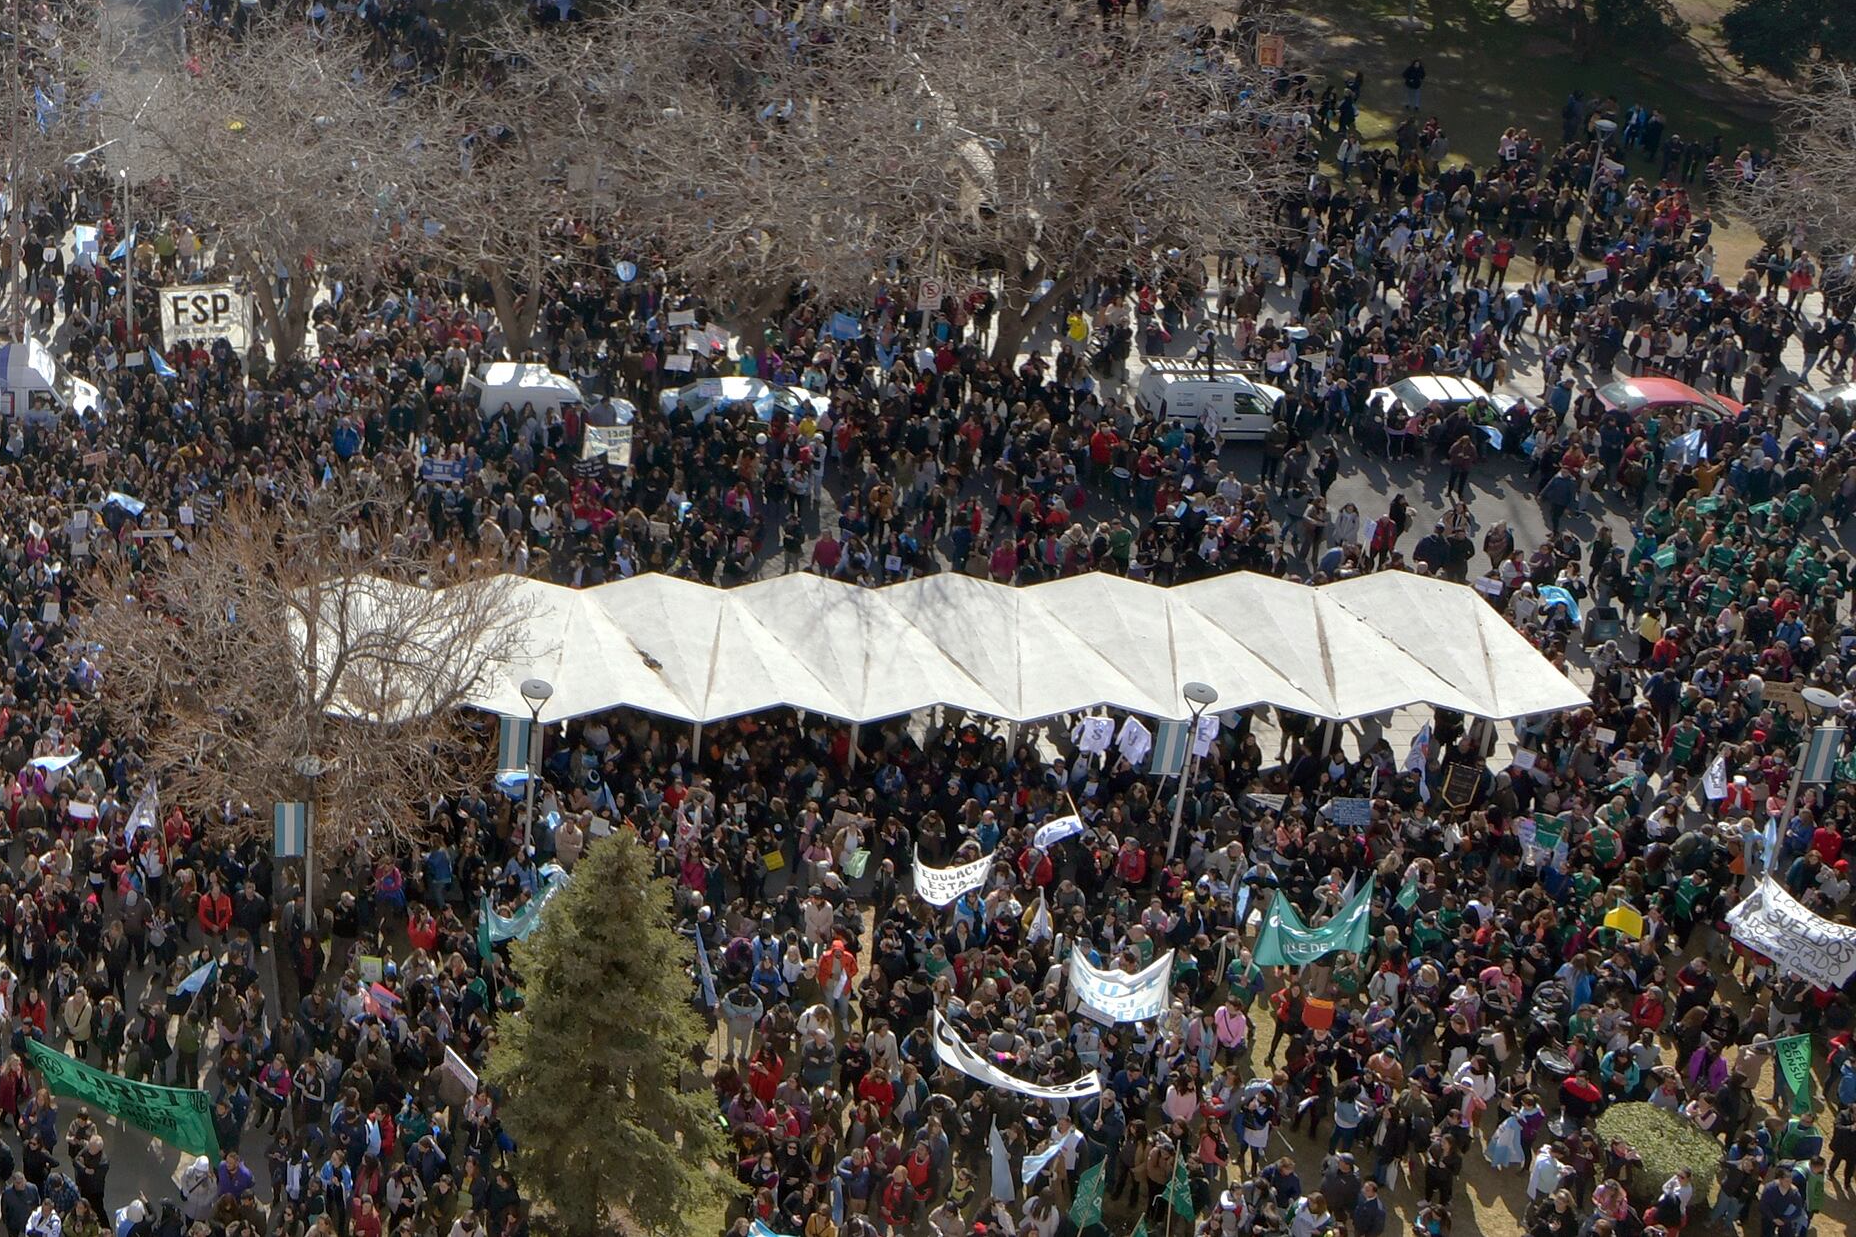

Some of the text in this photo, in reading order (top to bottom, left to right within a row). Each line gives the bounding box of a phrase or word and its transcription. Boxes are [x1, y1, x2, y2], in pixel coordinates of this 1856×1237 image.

[172, 293, 229, 326] FSP
[1767, 908, 1856, 965] SUELDOS
[1777, 934, 1841, 977] ESTADO
